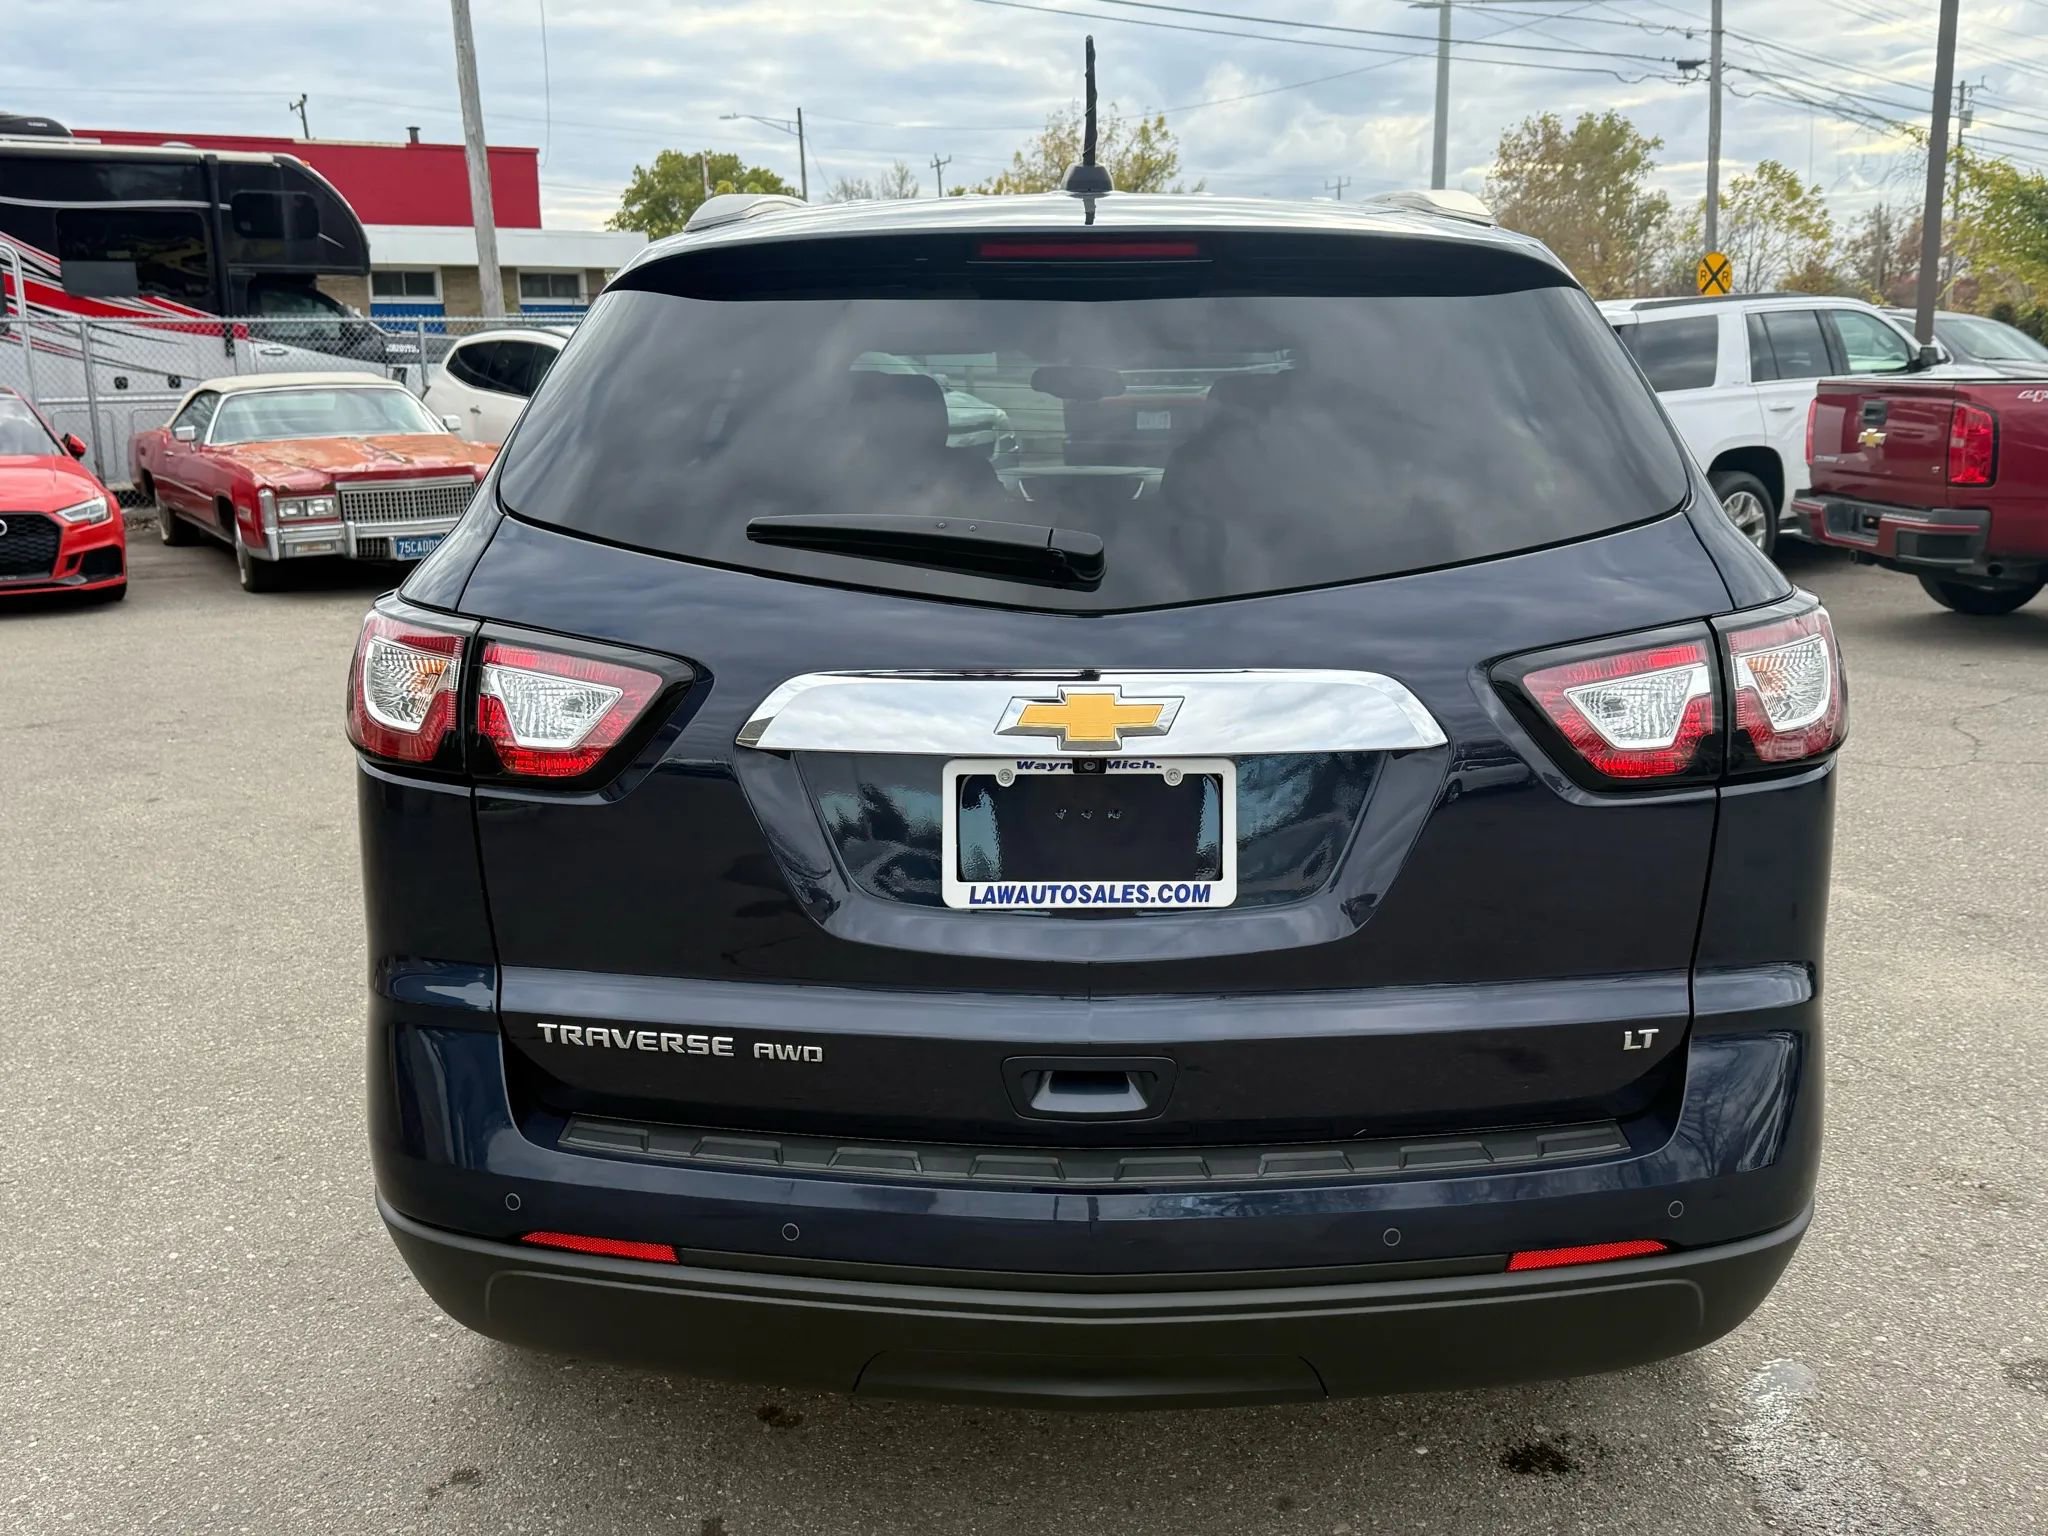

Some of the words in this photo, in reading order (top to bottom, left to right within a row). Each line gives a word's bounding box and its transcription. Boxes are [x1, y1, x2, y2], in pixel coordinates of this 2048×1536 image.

[1016, 760, 1073, 771] Wayn
[1106, 760, 1162, 769] Mich.
[969, 884, 1212, 905] LAWAUTOSALES.COM
[537, 1023, 734, 1056] TRAVERSE
[753, 1043, 823, 1062] AWD
[1623, 1028, 1659, 1050] LT
